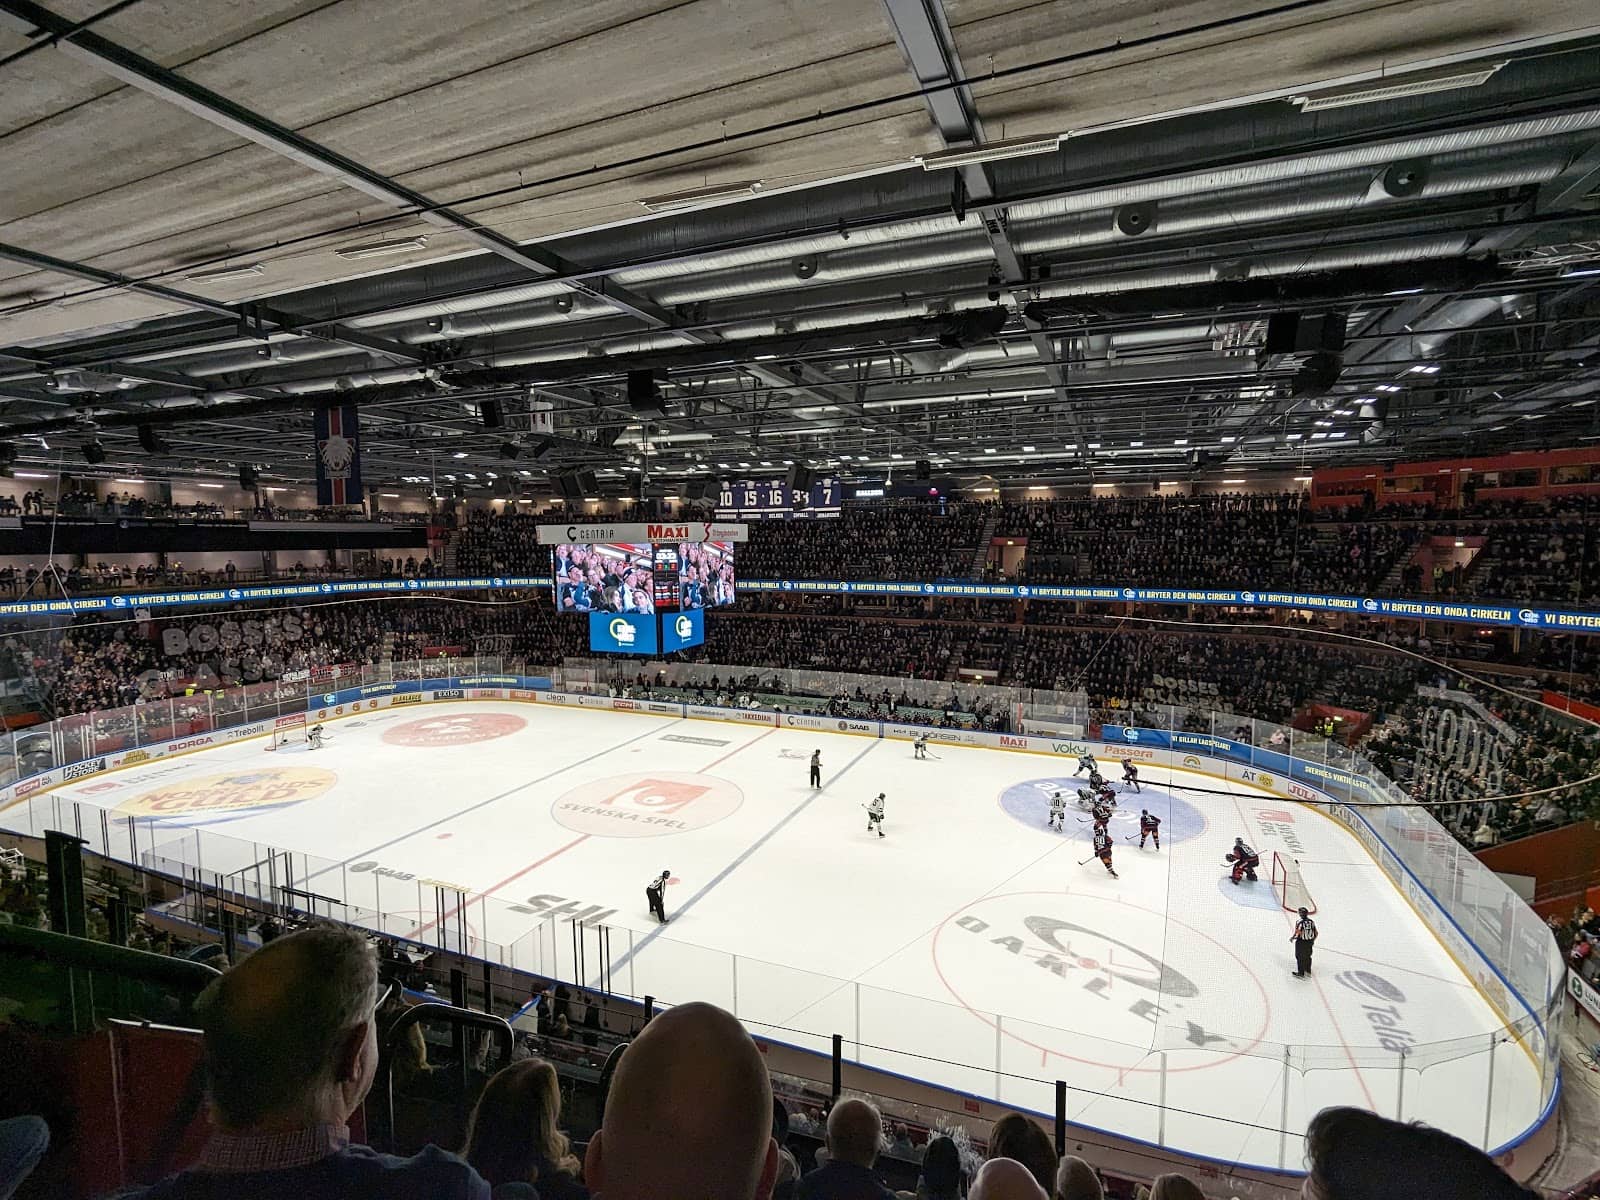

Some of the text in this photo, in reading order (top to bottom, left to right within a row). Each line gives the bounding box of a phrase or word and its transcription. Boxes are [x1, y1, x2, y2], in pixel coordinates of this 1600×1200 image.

[720, 492, 732, 506] 10
[744, 490, 757, 506] 15
[769, 490, 782, 505] 16
[823, 489, 832, 504] 7
[648, 524, 688, 538] MAXI
[1258, 594, 1358, 609] VI BRYTER DEN ONDA CIRKELN
[1382, 602, 1511, 620] VI BRYTER DEN ONDA CIRKELN
[1545, 614, 1600, 628] VI BRYTER
[234, 724, 264, 738] Trebolit
[168, 736, 214, 752] BORGA
[1000, 736, 1028, 746] MAXI
[1104, 745, 1153, 758] Passera
[65, 760, 100, 777] HOCKEY
[72, 766, 100, 778] STORE
[1242, 770, 1256, 782] ÄT
[16, 781, 38, 794] CCM
[1289, 785, 1318, 800] JULA
[560, 802, 688, 830] SVENSKA SPEL
[1362, 1003, 1416, 1055] Telia
